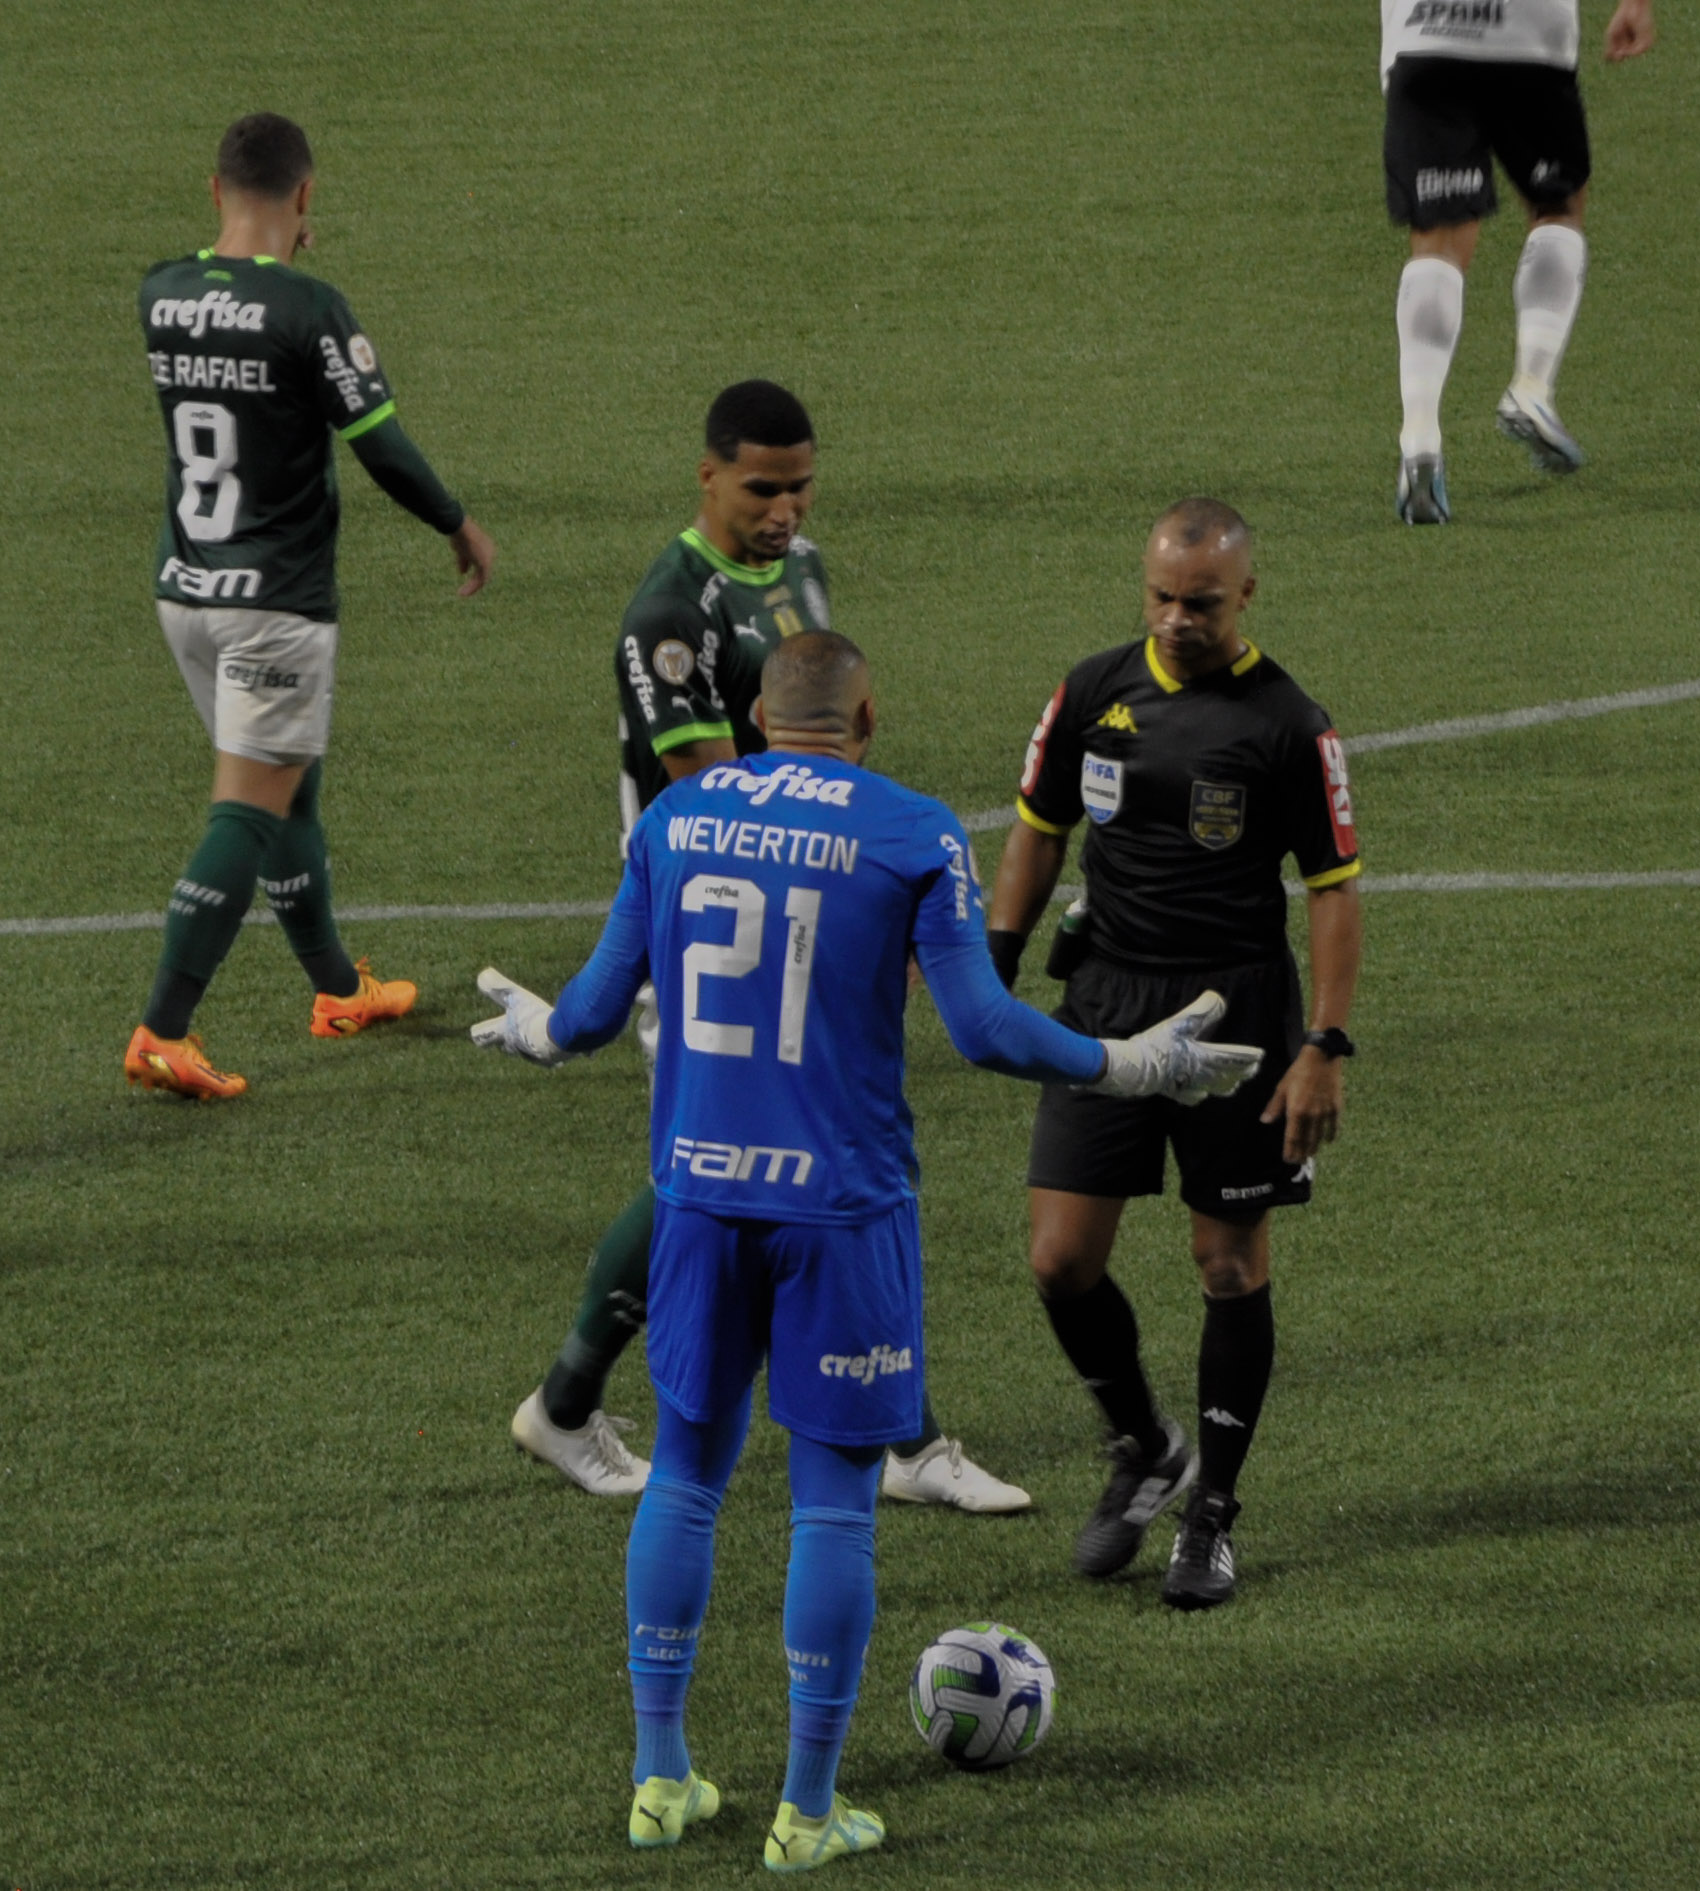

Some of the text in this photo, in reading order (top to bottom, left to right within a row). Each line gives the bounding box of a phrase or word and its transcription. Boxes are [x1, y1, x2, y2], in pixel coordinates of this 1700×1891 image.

[151, 290, 266, 339] crefisa
[173, 354, 277, 392] RAFAEL
[319, 335, 365, 412] crefisa
[173, 401, 242, 542] 8
[624, 635, 667, 723] crefisa
[700, 763, 854, 806] crefisa
[1085, 759, 1116, 782] FIFA
[668, 816, 859, 875] WEVERTON
[705, 885, 739, 899] crefisa
[794, 924, 807, 965] crefisa
[681, 873, 823, 1066] 21
[819, 1343, 913, 1386] crefisa
